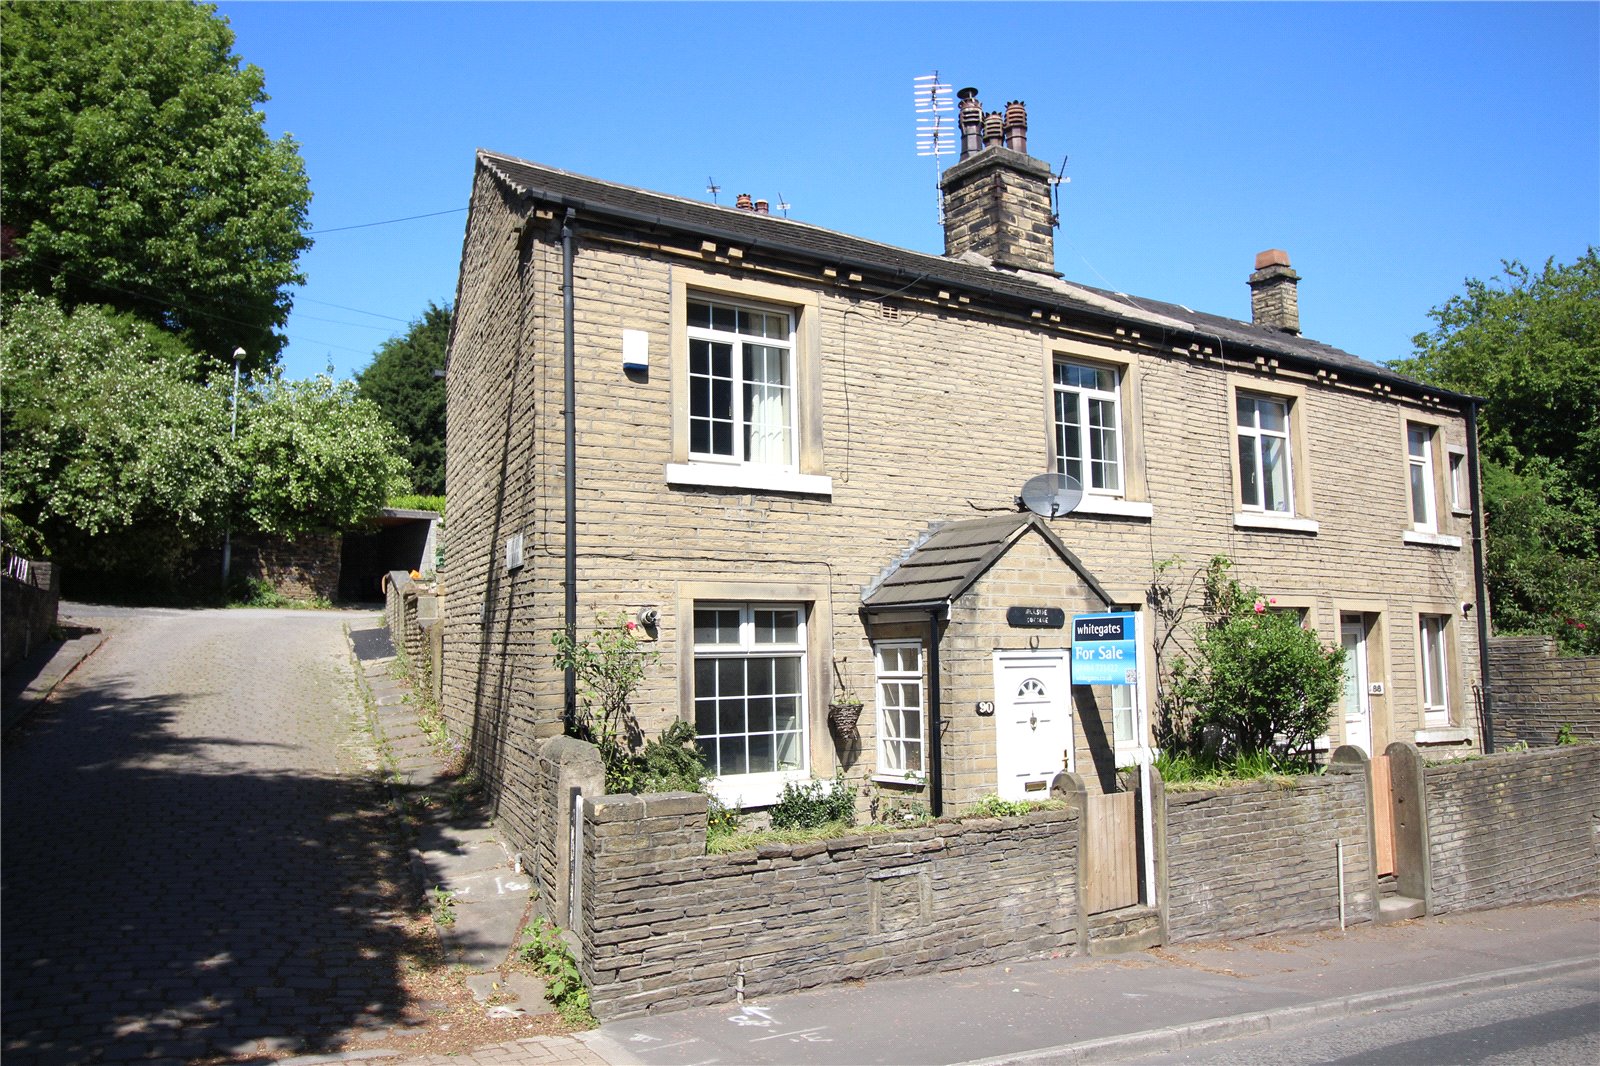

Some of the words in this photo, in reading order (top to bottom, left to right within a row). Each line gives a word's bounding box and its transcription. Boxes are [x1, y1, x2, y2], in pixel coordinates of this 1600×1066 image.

[1077, 624, 1121, 637] whitegates
[1075, 646, 1095, 660] For
[1098, 646, 1123, 660] Sale
[1373, 684, 1382, 693] 88
[979, 701, 994, 713] 90
